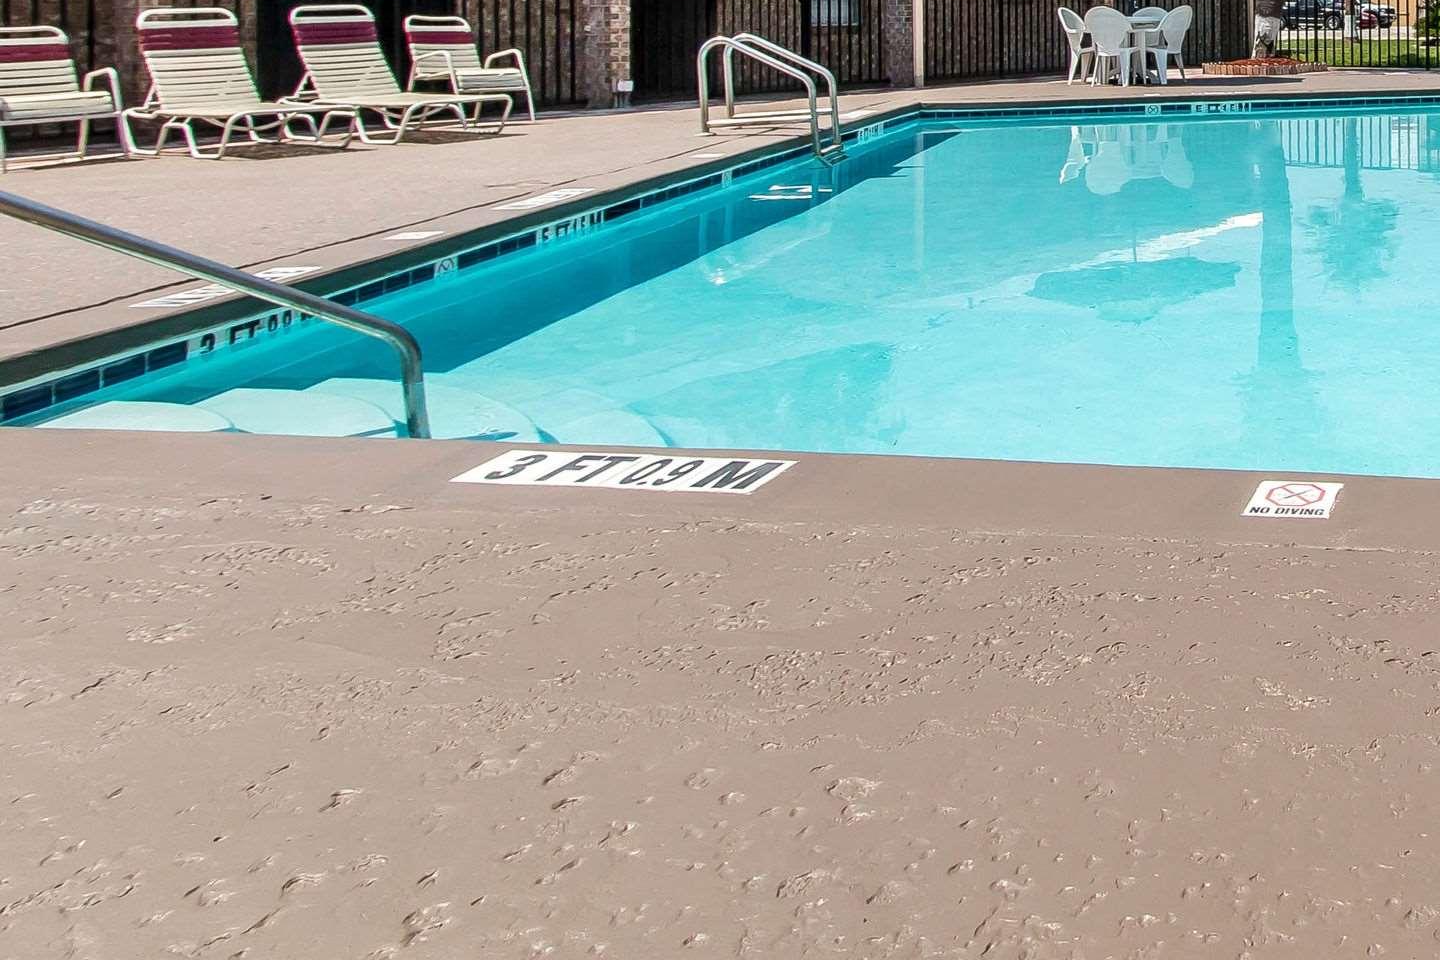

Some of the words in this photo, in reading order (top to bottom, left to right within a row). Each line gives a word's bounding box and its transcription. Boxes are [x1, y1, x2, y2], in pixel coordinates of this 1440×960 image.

[485, 454, 548, 480] 3
[537, 455, 641, 483] FT
[618, 458, 695, 486] 0.9
[689, 460, 785, 490] M
[1249, 506, 1271, 515] NO
[1274, 507, 1326, 516] DIVING
